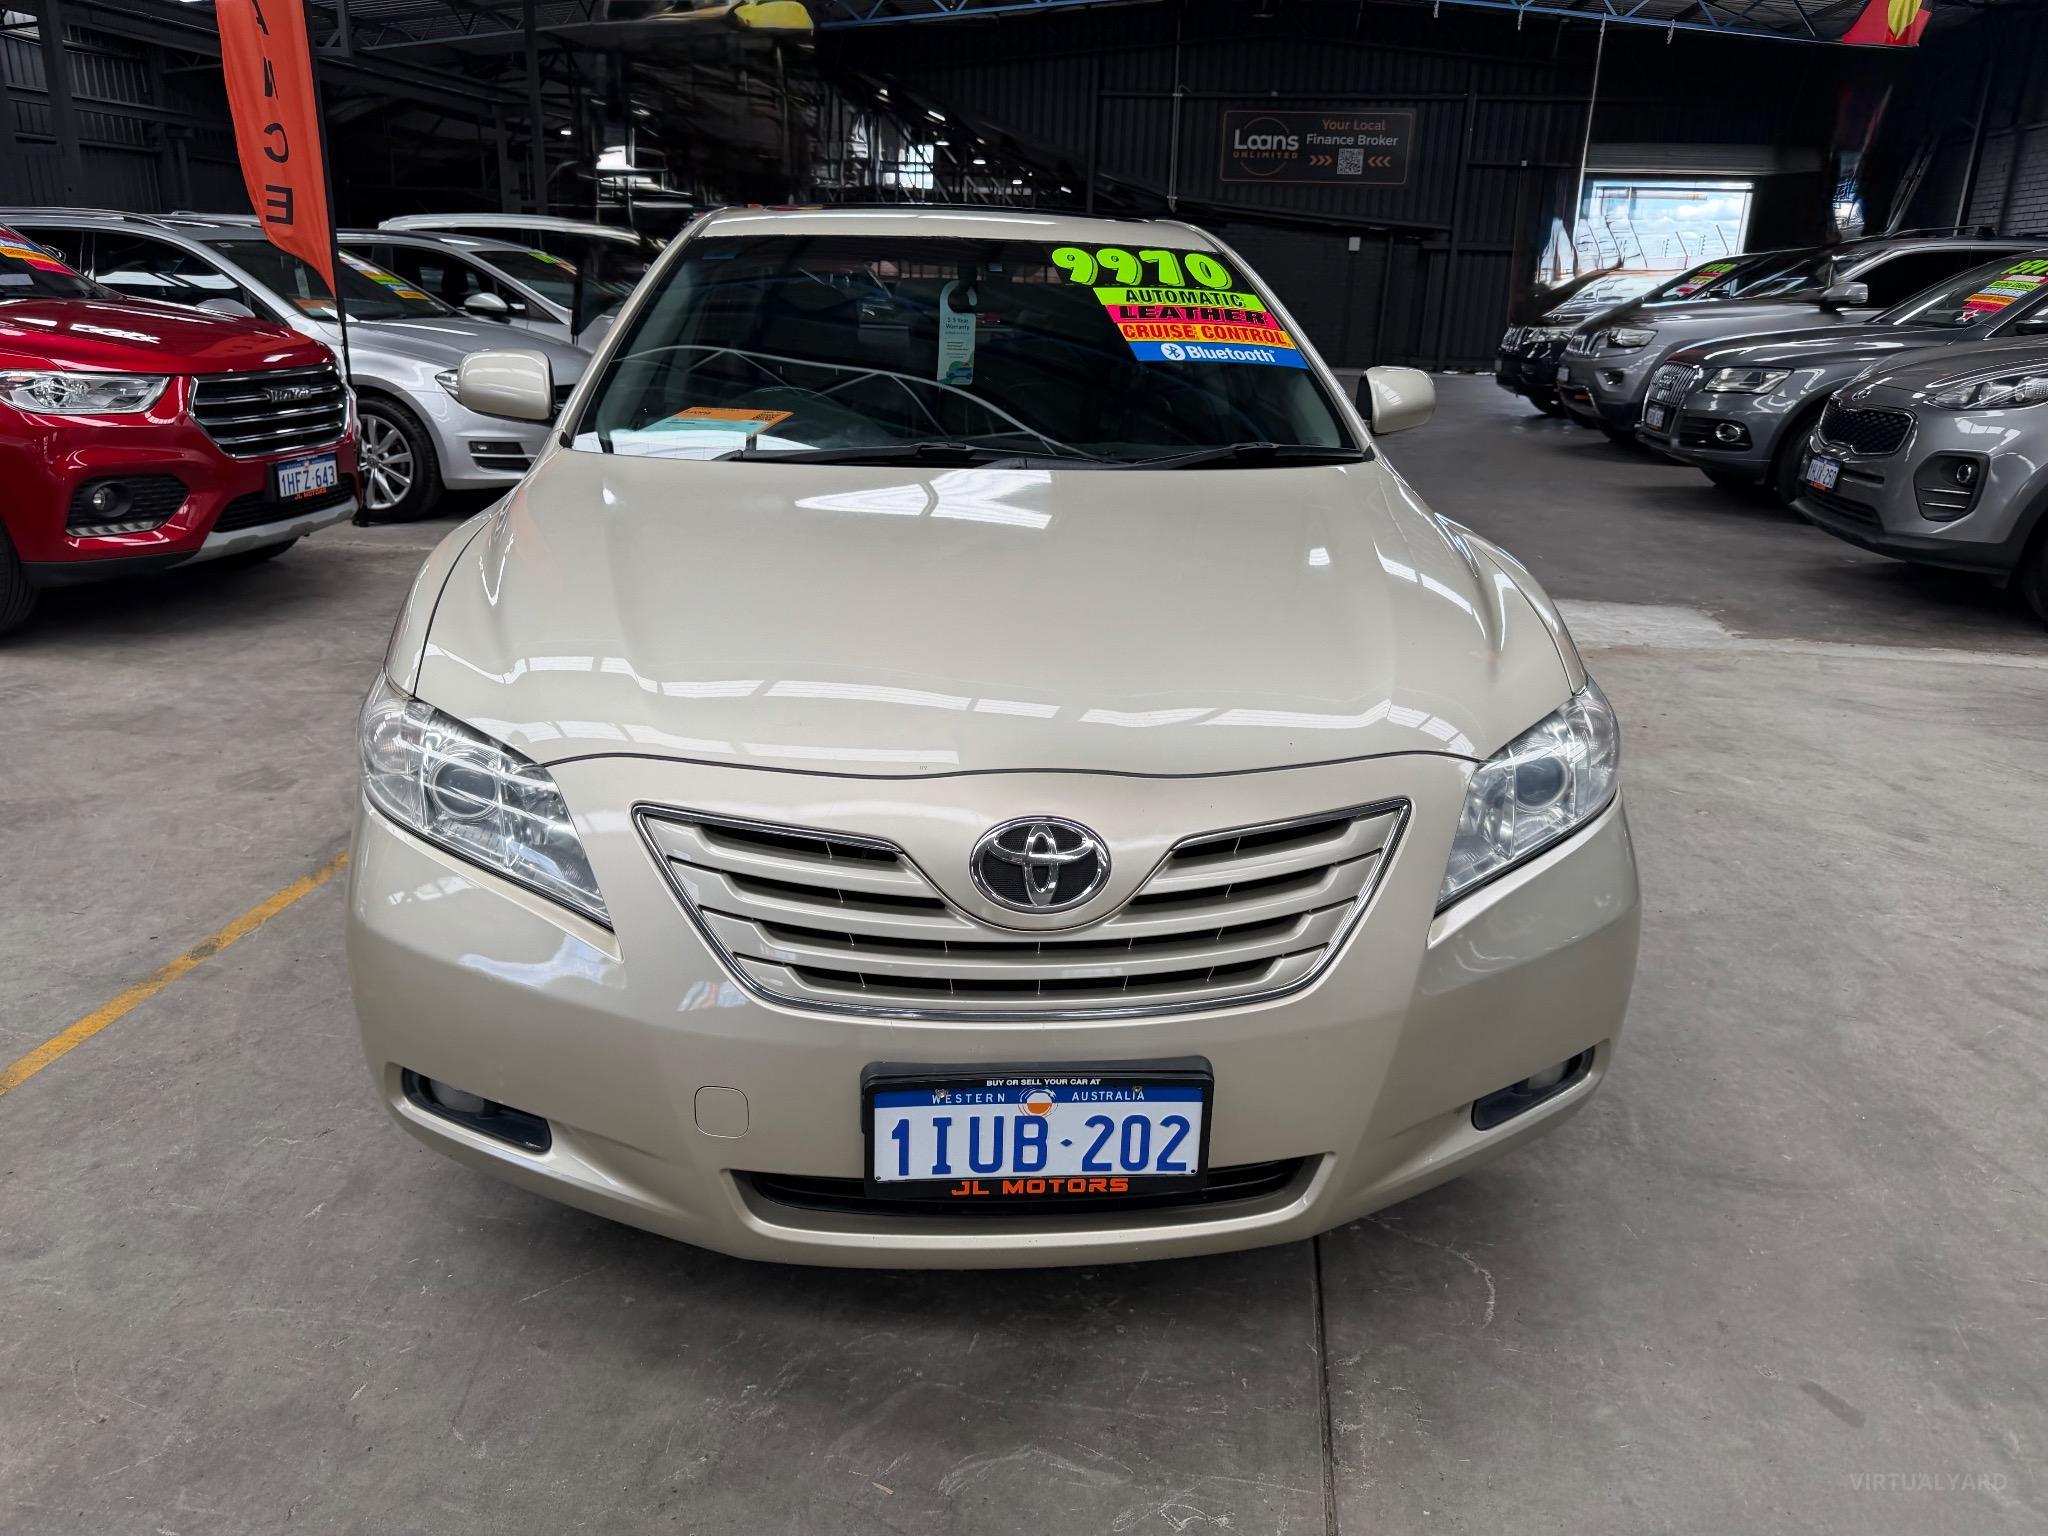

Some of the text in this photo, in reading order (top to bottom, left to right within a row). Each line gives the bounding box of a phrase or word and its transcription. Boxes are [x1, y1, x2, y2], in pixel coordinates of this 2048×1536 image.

[1322, 119, 1386, 131] Your Local
[1234, 129, 1299, 151] Loans
[1306, 133, 1399, 147] Finance Broker
[1233, 151, 1299, 160] UNLIMITED
[1051, 247, 1233, 289] 9970
[1125, 289, 1244, 308] AUTOMATIC
[1119, 306, 1269, 325] LEATHER
[1122, 324, 1288, 345] CRUISE CONTROL
[986, 1078, 1102, 1087] BUY OR SELL YOUR CAR AT
[931, 1090, 1146, 1105] WESTERN AUSTRALIA
[951, 1178, 1129, 1196] JL MOTORS
